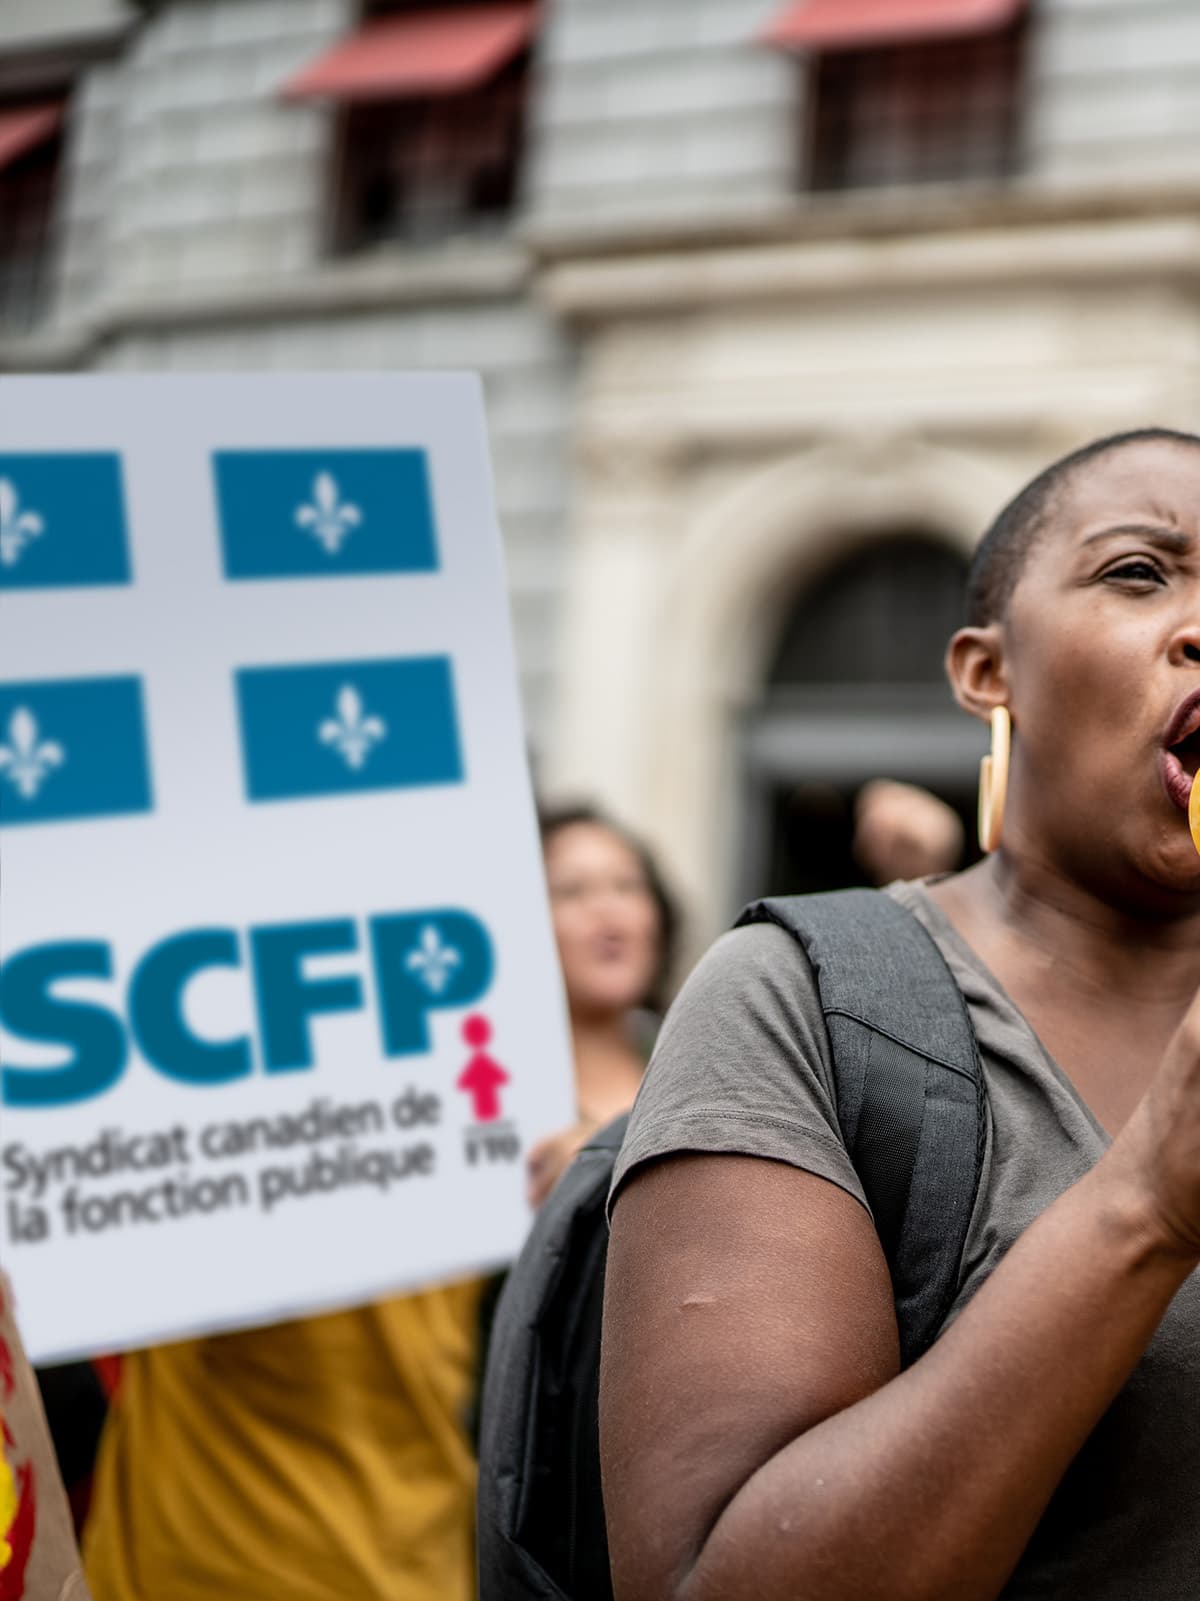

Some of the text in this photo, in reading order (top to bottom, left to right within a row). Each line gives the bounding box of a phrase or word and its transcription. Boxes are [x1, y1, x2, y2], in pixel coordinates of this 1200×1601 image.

[0, 906, 496, 1109] SCFP
[2, 1125, 190, 1199] Syndicat
[200, 1096, 384, 1162] canadien
[391, 1085, 442, 1130] de
[7, 1197, 50, 1246] la
[63, 1170, 249, 1236] fonction
[258, 1140, 435, 1214] publique
